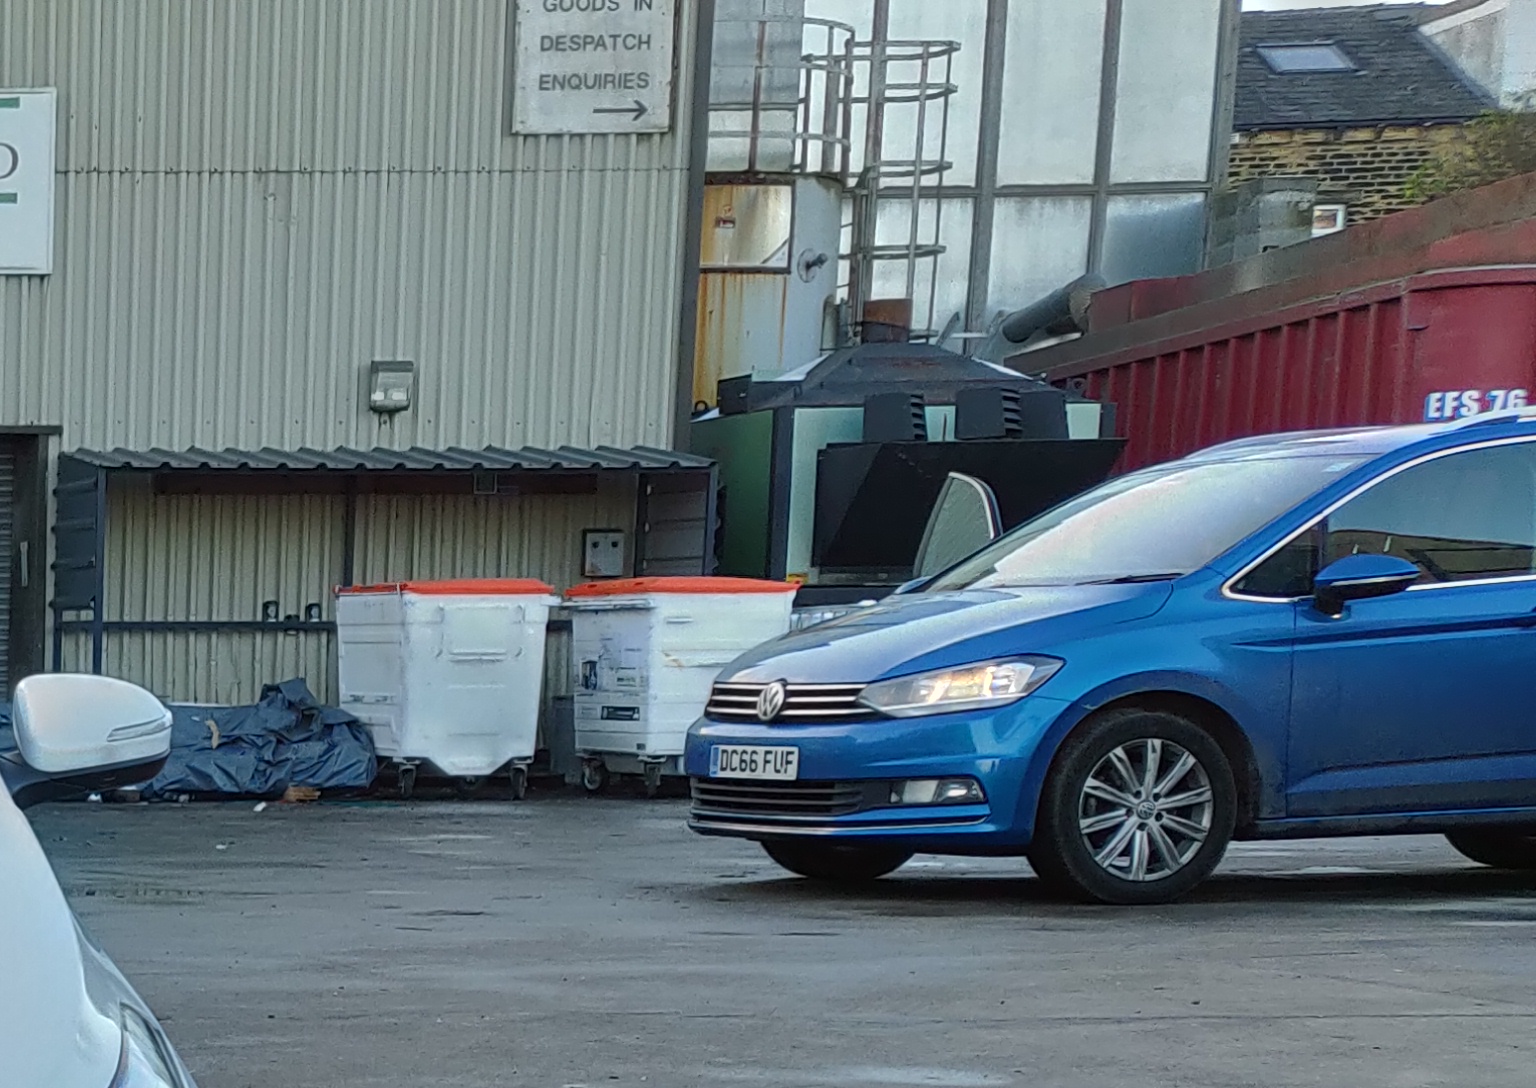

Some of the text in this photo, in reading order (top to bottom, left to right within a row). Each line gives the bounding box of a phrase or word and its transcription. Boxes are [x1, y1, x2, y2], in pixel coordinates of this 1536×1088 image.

[543, 0, 653, 12] GOODS IN
[540, 34, 651, 51] DESPATCH
[538, 72, 650, 91] ENQUIRIES
[1426, 390, 1481, 420] EFS
[719, 749, 795, 774] DC66 FUF
